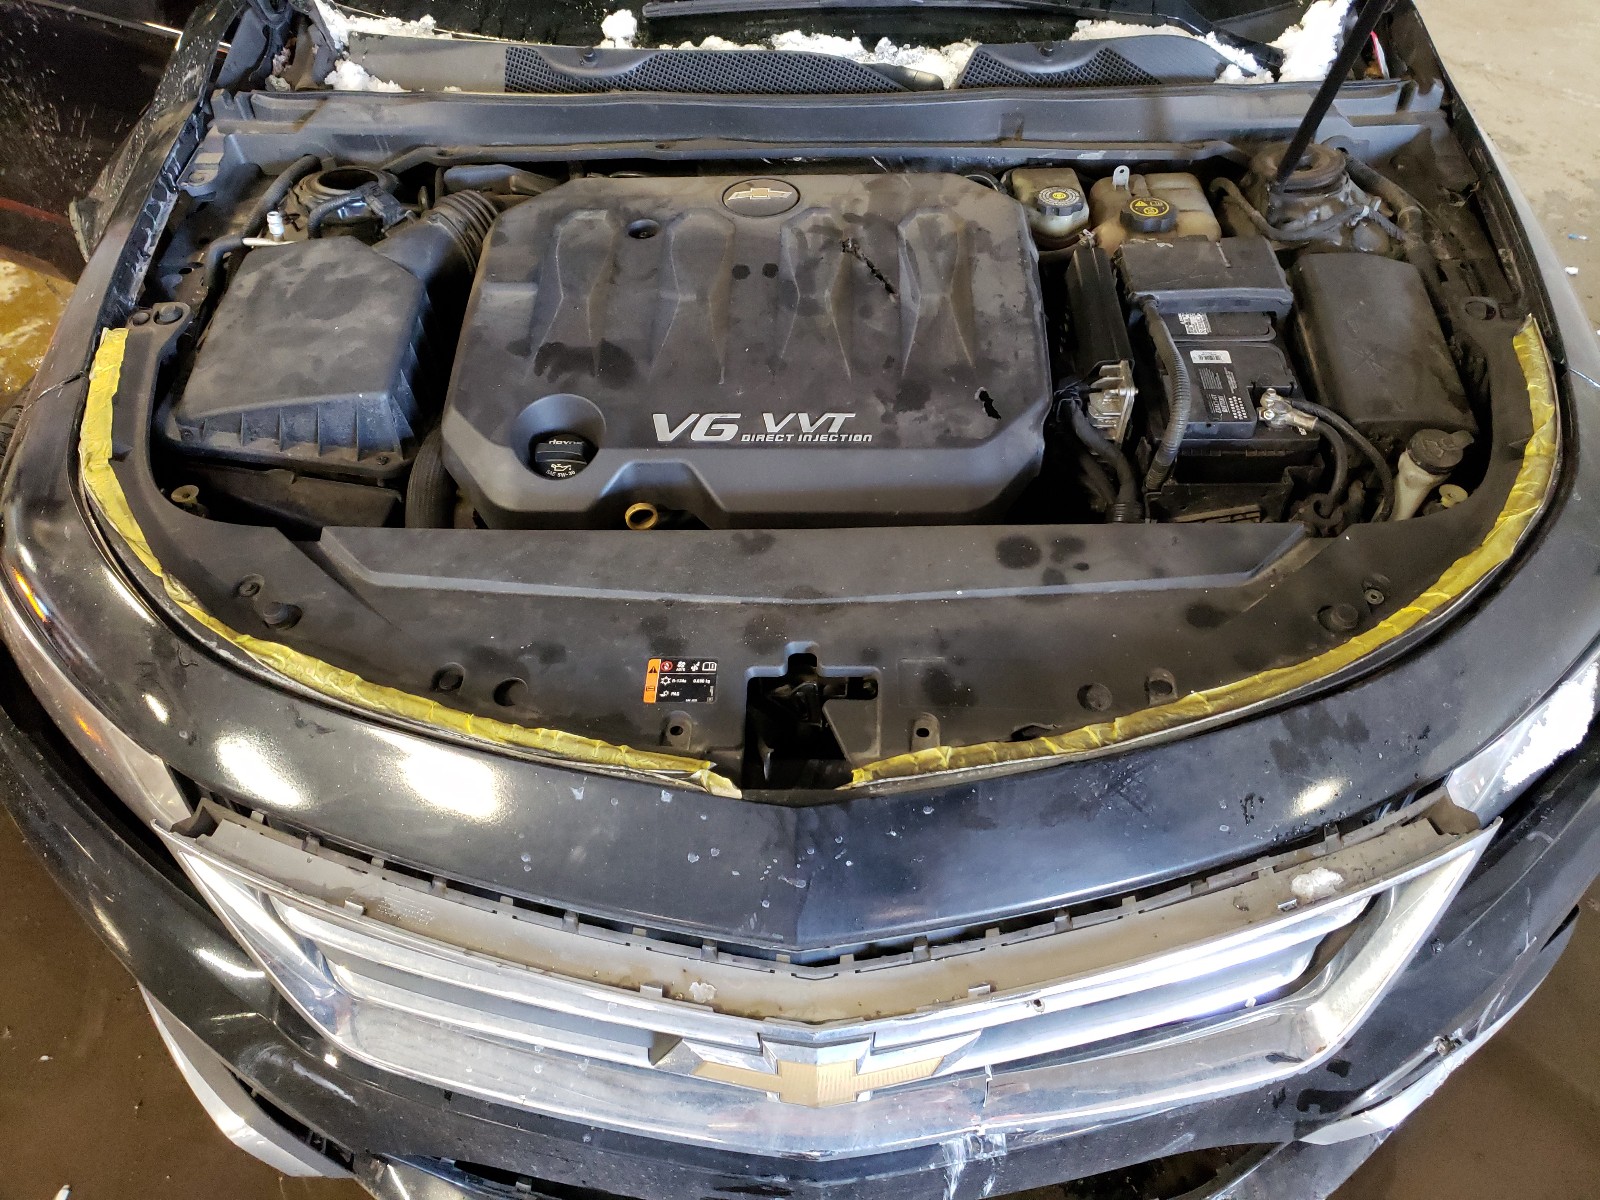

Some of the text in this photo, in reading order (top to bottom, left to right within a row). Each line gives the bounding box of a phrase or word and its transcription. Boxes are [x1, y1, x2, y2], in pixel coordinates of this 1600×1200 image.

[652, 412, 856, 442] V6 VVT
[741, 434, 873, 442] DIRECT INJECTION
